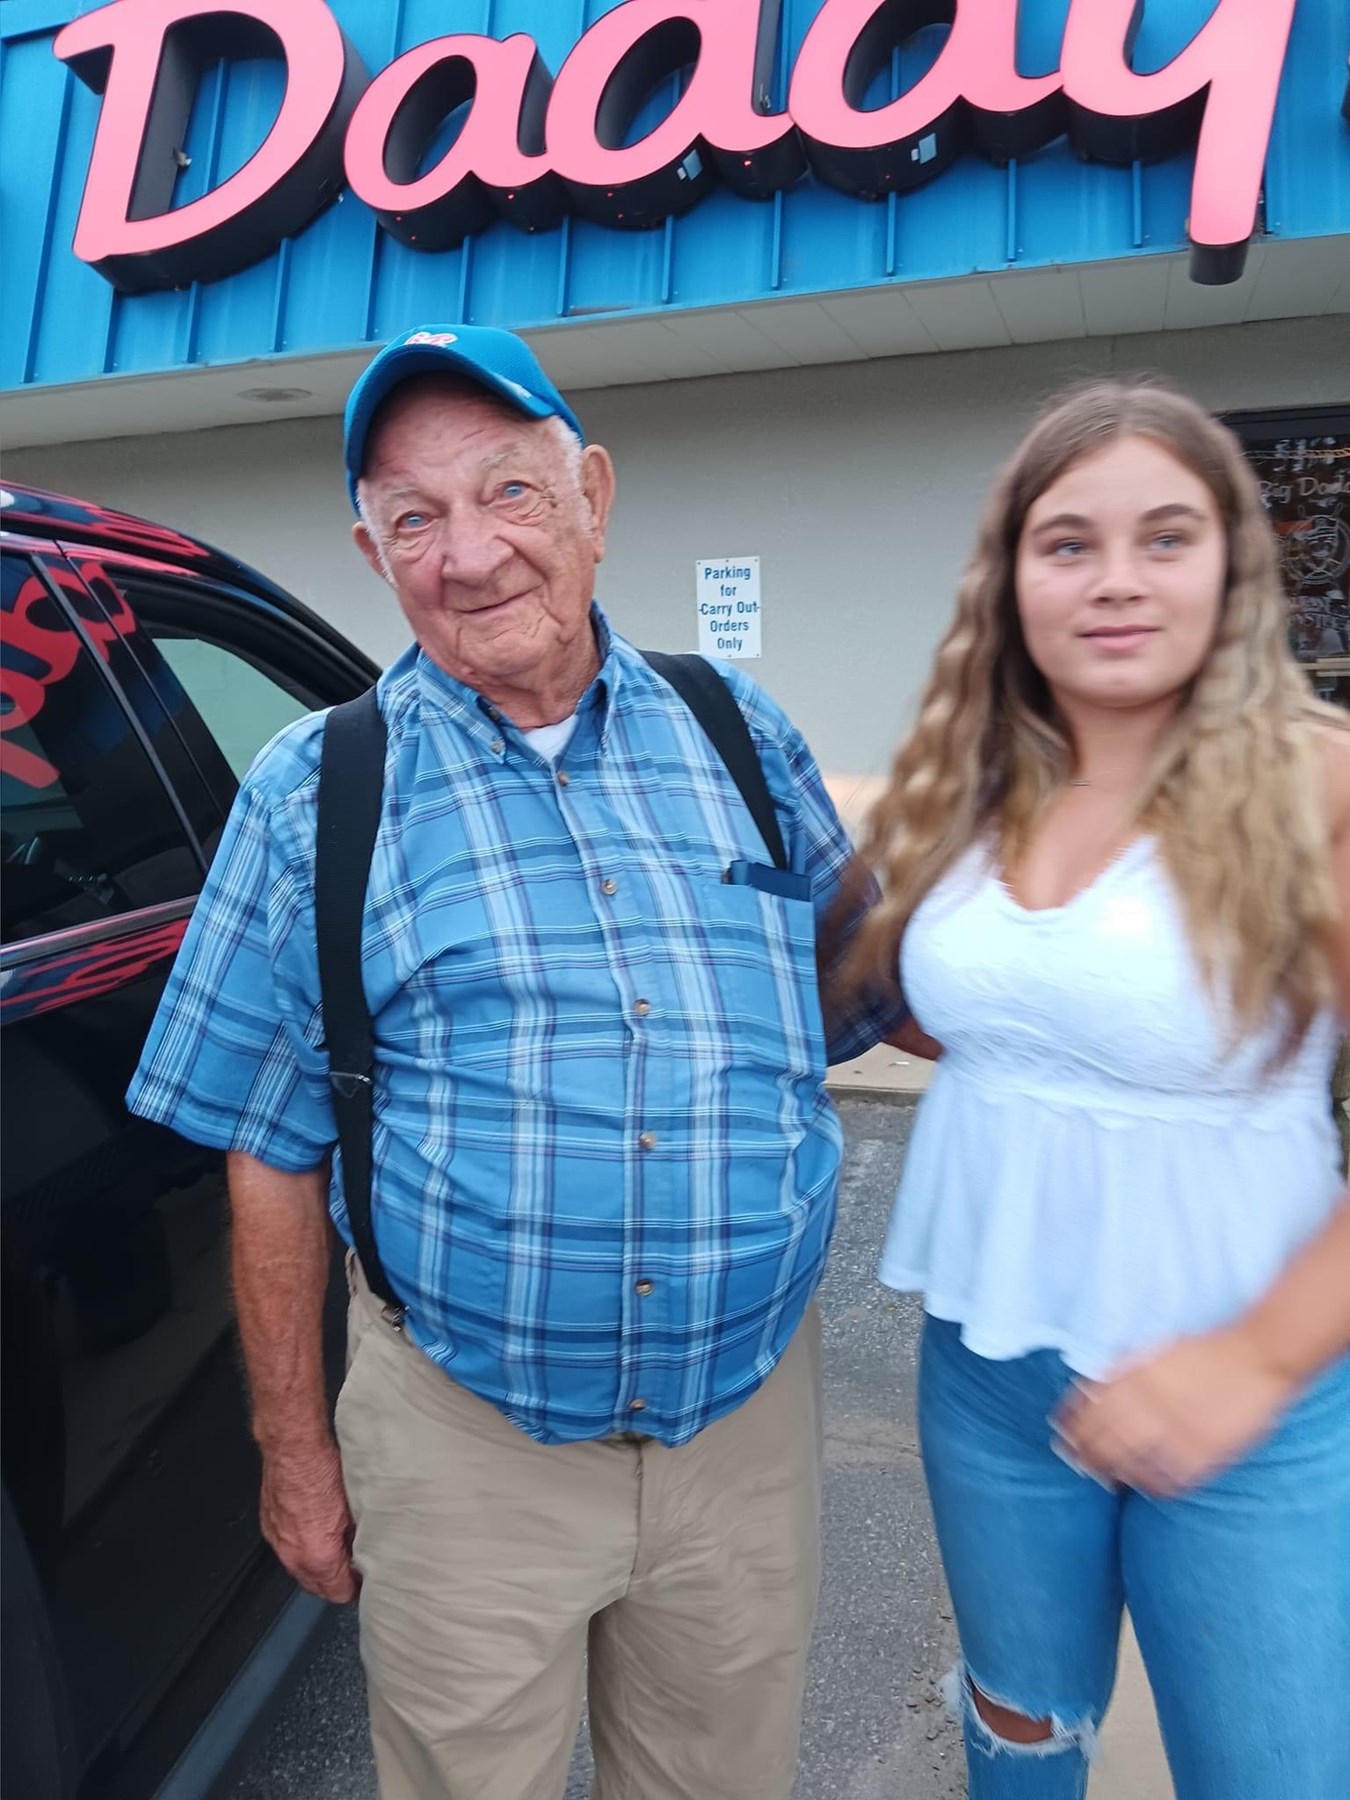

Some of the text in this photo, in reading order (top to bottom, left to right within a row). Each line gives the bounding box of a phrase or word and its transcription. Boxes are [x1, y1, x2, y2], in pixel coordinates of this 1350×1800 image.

[704, 566, 751, 580] Parking
[720, 584, 737, 597] for
[701, 601, 757, 617] Carry Out
[710, 620, 749, 632] Orders
[717, 637, 743, 651] Only
